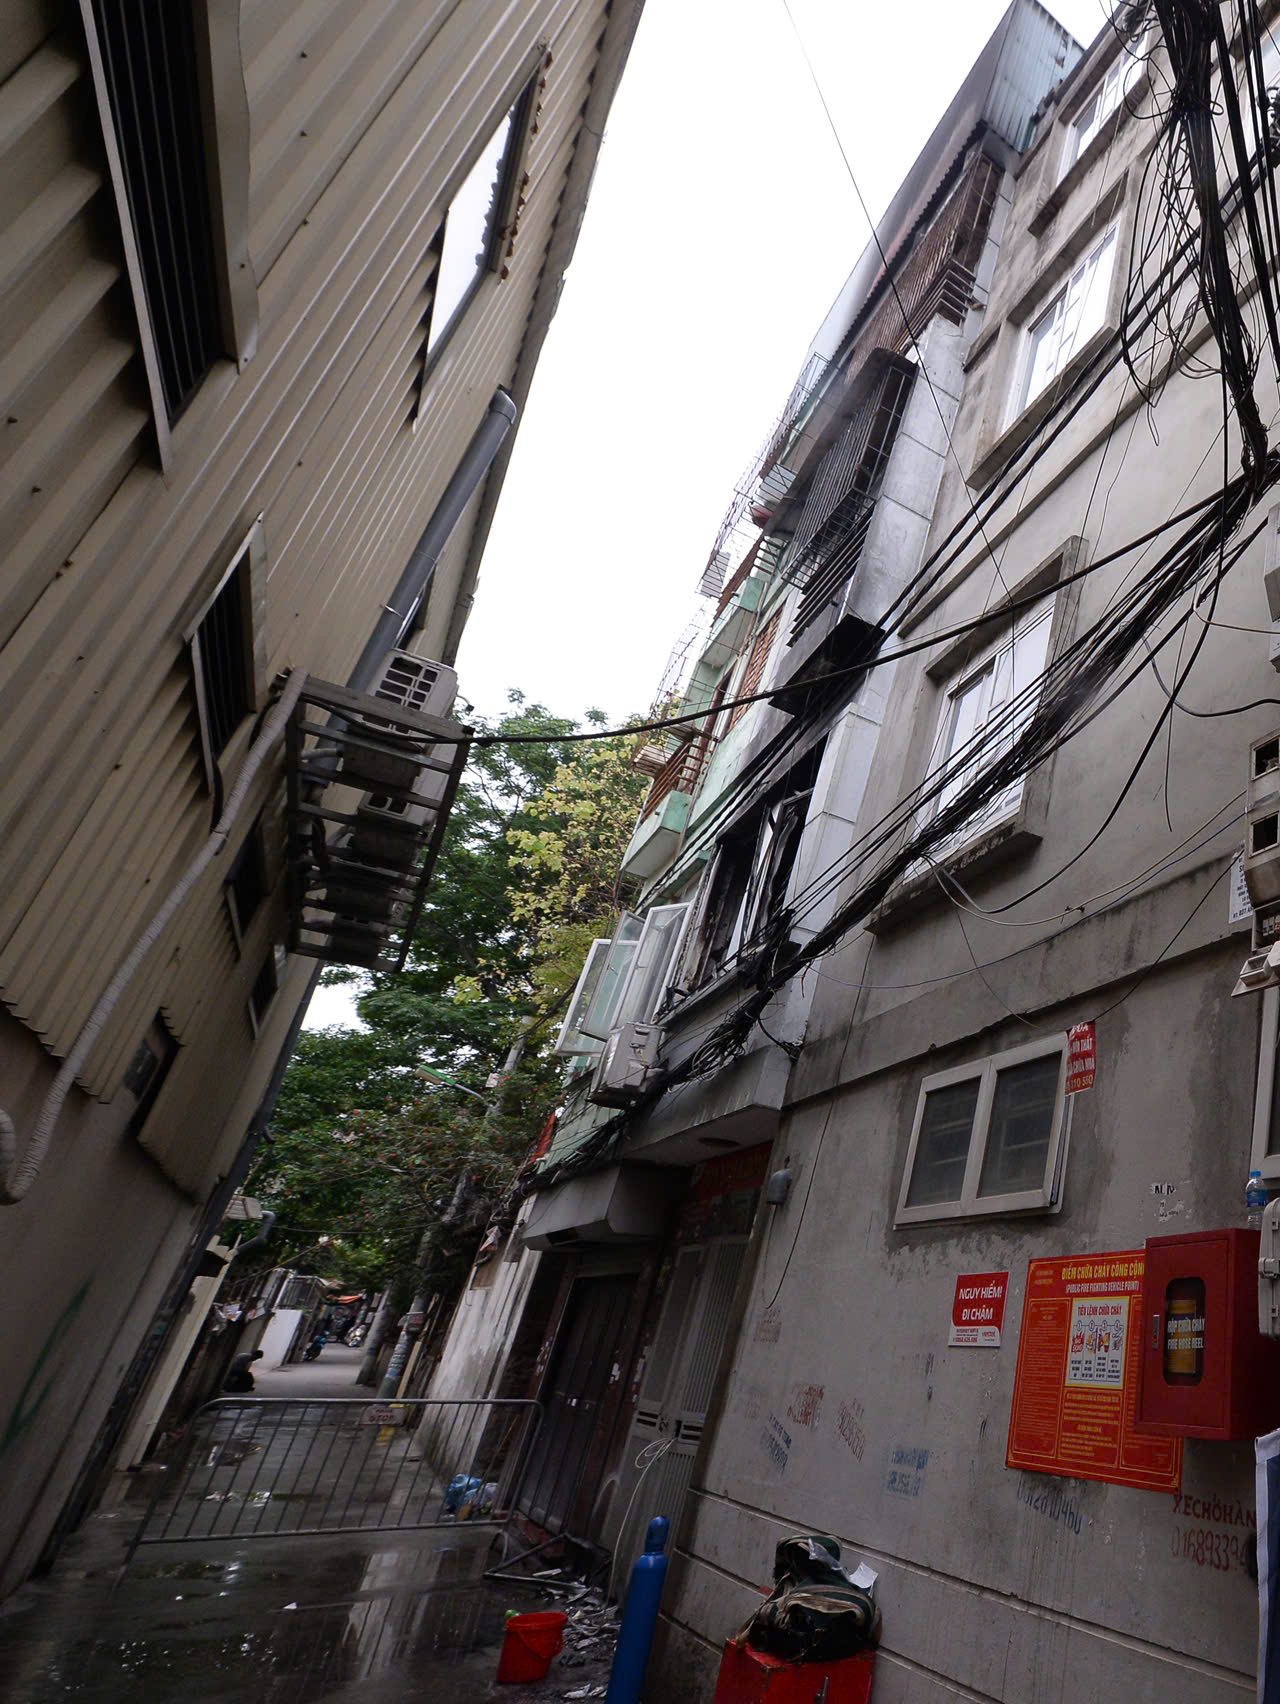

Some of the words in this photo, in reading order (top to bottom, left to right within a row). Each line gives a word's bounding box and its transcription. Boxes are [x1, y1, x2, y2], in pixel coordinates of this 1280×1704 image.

[959, 1288, 980, 1299] NGUY
[980, 1280, 1002, 1298] HIỂM!
[962, 1308, 970, 1320] ĐI
[970, 1304, 993, 1322] CHẬM
[1167, 1338, 1178, 1349] FIRE
[1191, 1337, 1204, 1348] REEL
